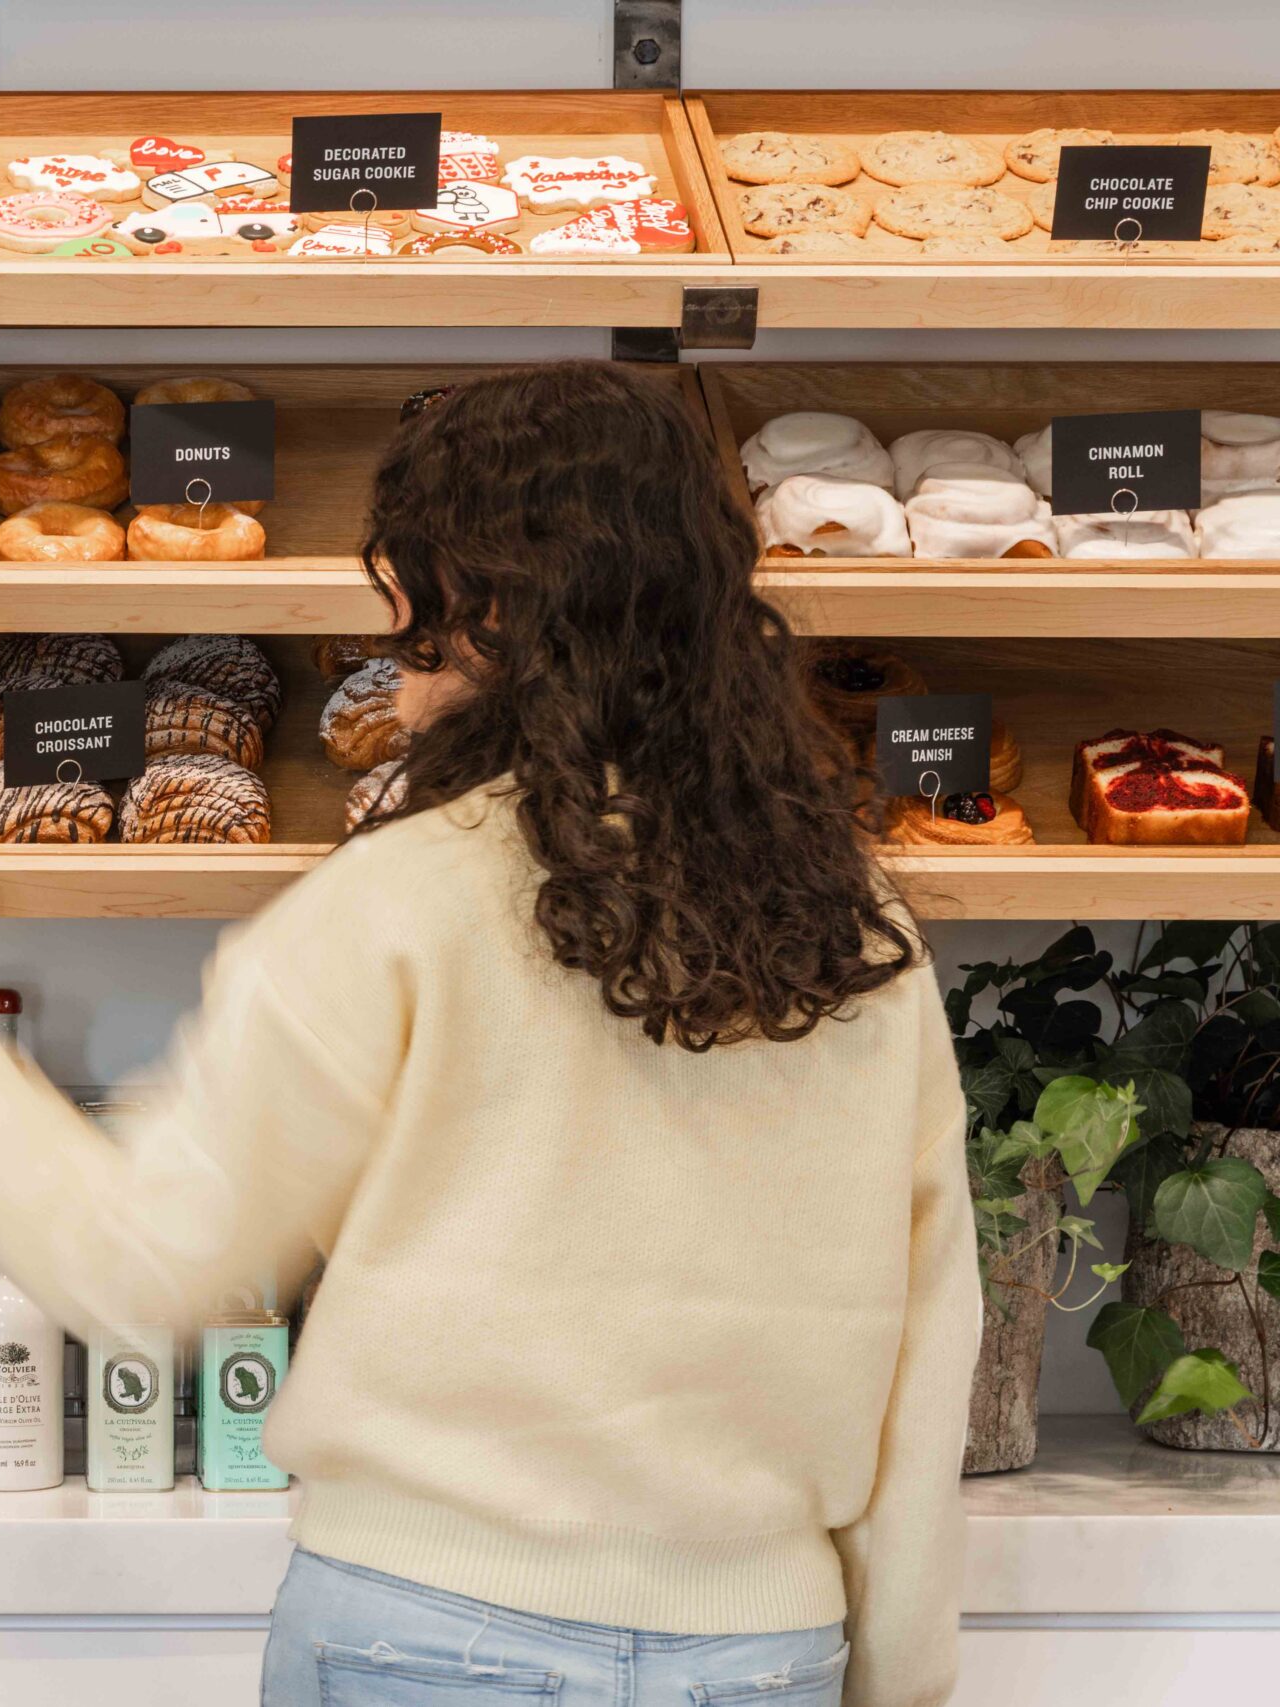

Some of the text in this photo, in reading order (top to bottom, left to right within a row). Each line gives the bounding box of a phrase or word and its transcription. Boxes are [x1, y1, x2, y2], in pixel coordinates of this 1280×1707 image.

[133, 139, 203, 159] love
[324, 147, 406, 161] DECORATED
[313, 166, 416, 181] SUGAR COOKIE
[1090, 178, 1174, 191] CHOCOLATE
[1085, 197, 1174, 210] CHIP COOKIE
[175, 447, 230, 462] DONUTS
[1089, 444, 1164, 460] CINNAMON
[1109, 465, 1144, 479] ROLL
[35, 716, 113, 734] CHOCOLATE
[891, 727, 975, 743] CREAM CHEESE
[36, 735, 112, 754] CROISSANT
[911, 748, 953, 763] DANISH
[10, 1395, 41, 1403] D'OLIVE
[16, 1405, 41, 1413] EXTRA
